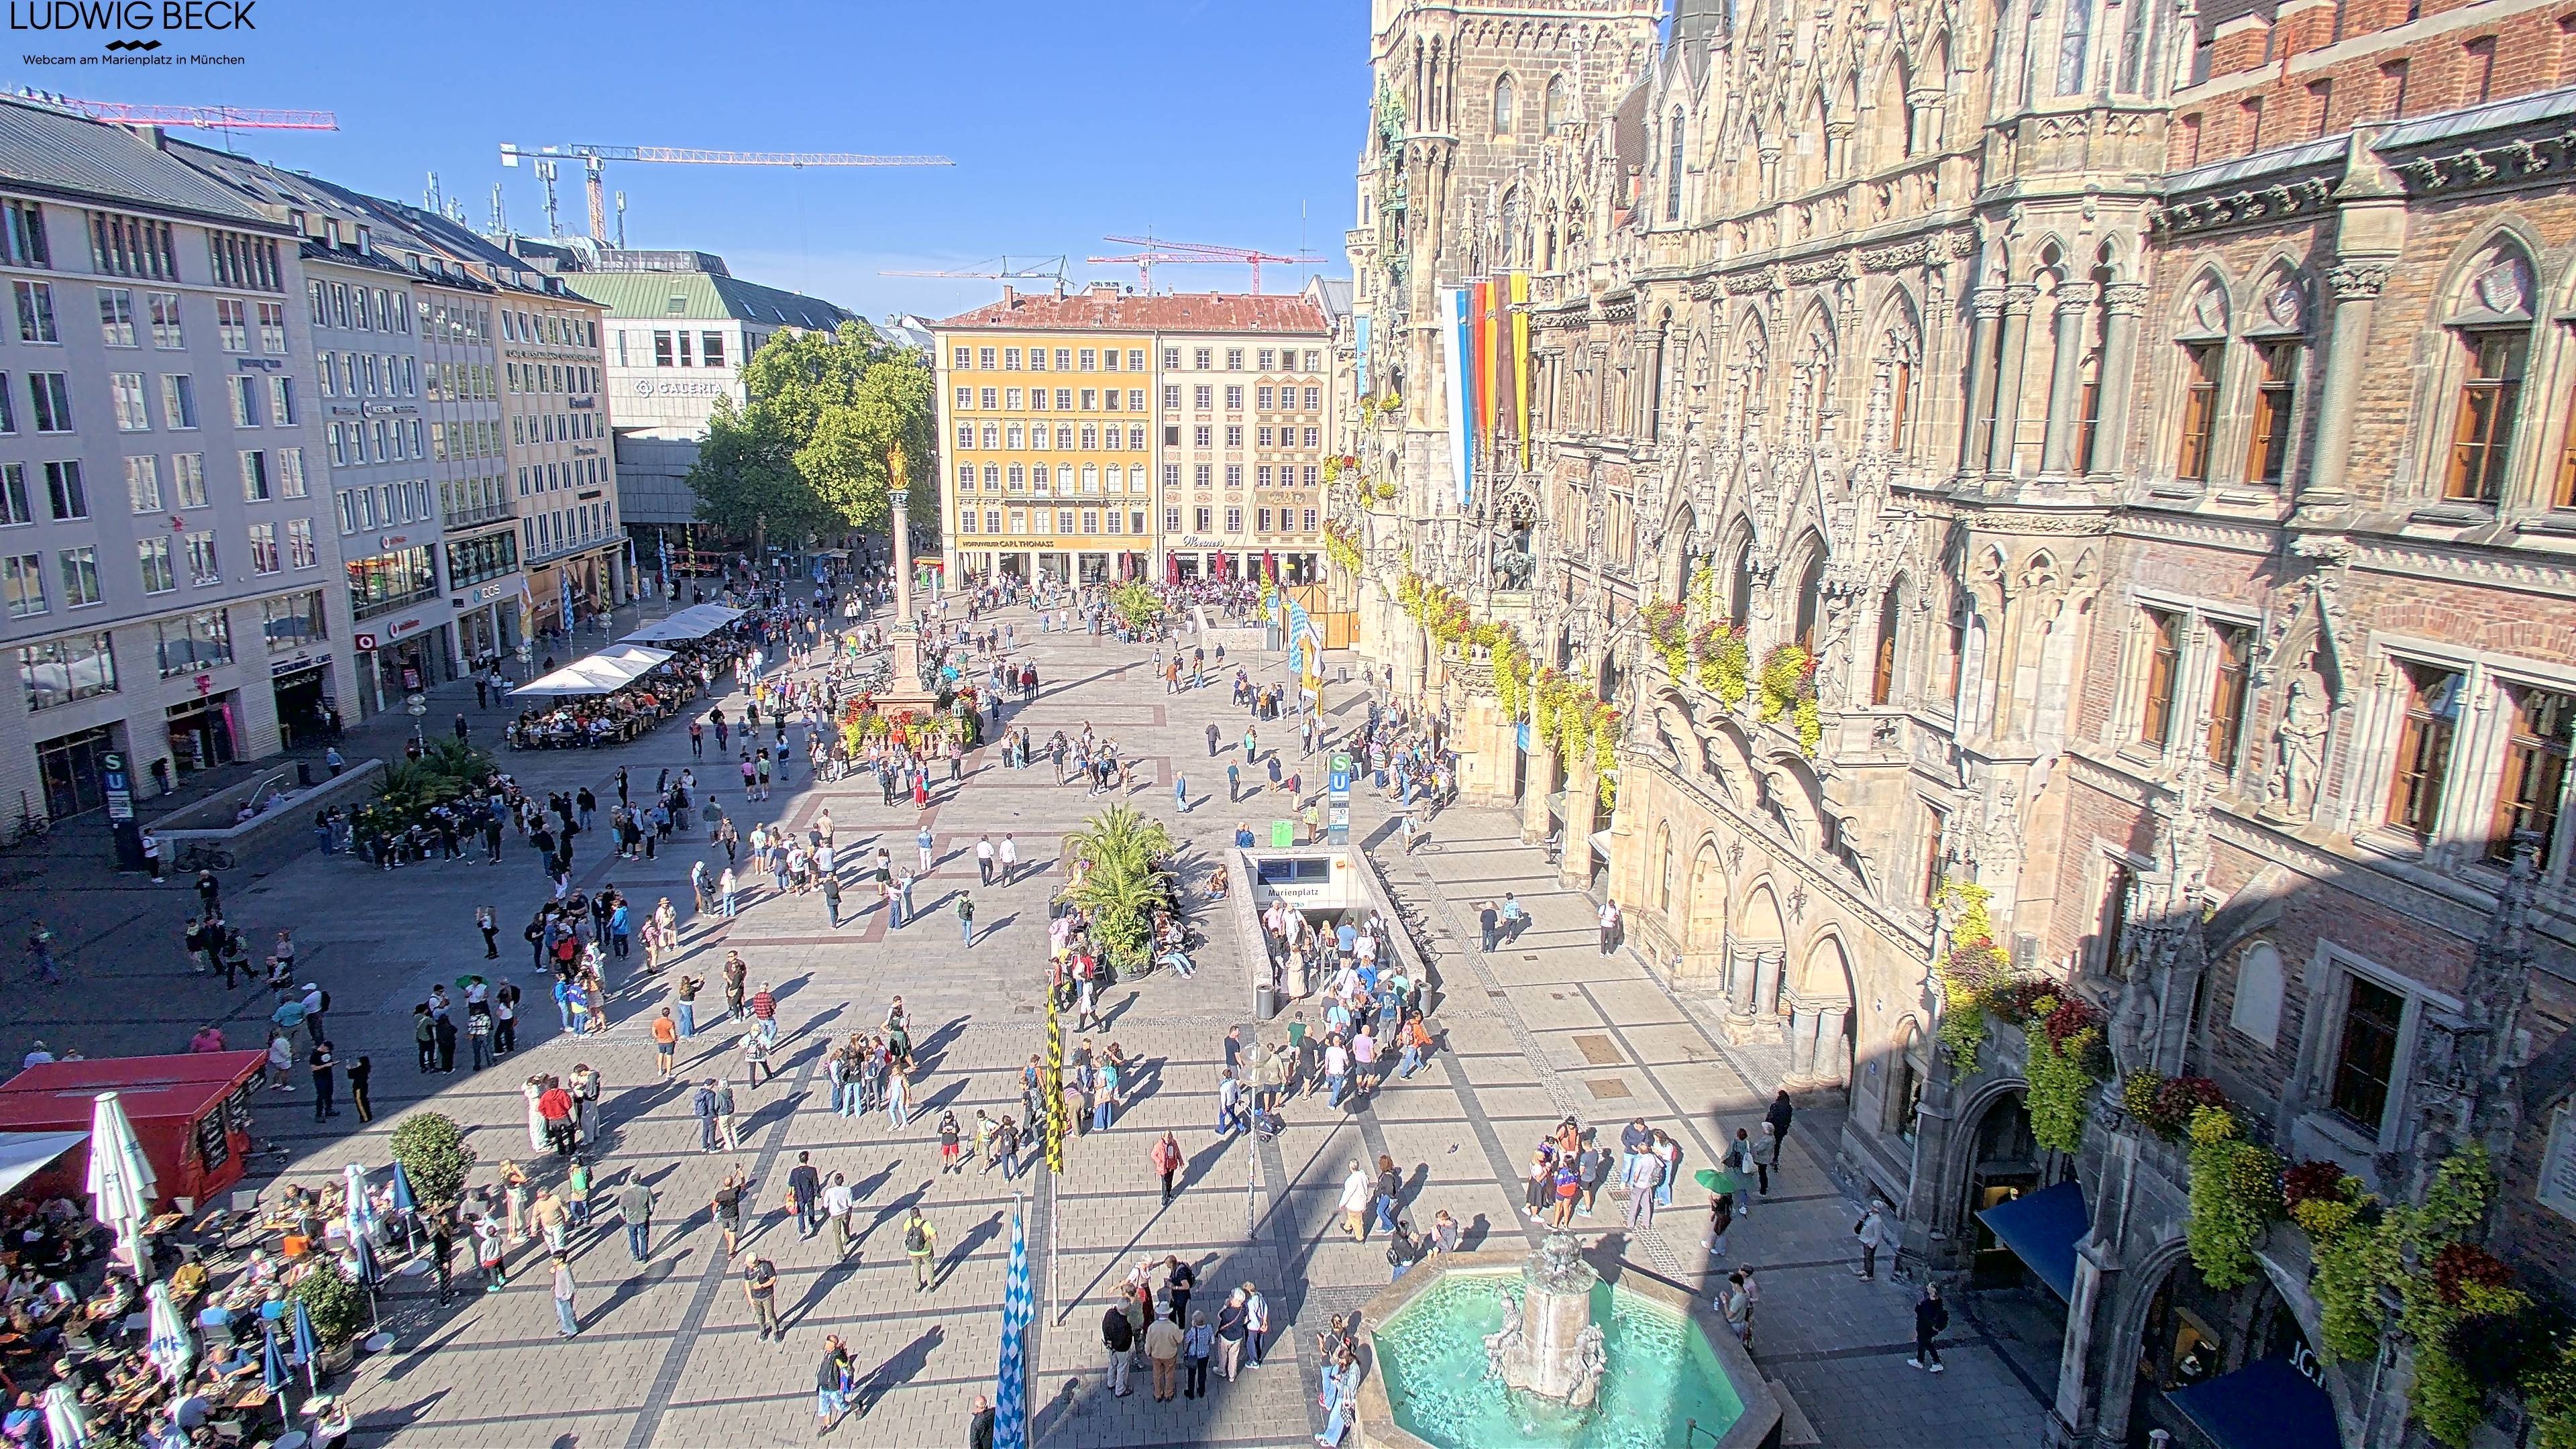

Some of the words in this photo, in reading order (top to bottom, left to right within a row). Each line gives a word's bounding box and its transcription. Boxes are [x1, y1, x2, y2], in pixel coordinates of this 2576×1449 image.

[658, 382, 722, 394] GALERIA
[1269, 597, 1277, 606] U
[106, 754, 121, 769] S
[1334, 755, 1346, 771] S
[109, 774, 123, 789] U
[1334, 775, 1346, 790] U
[1268, 888, 1319, 898] Marienplatz
